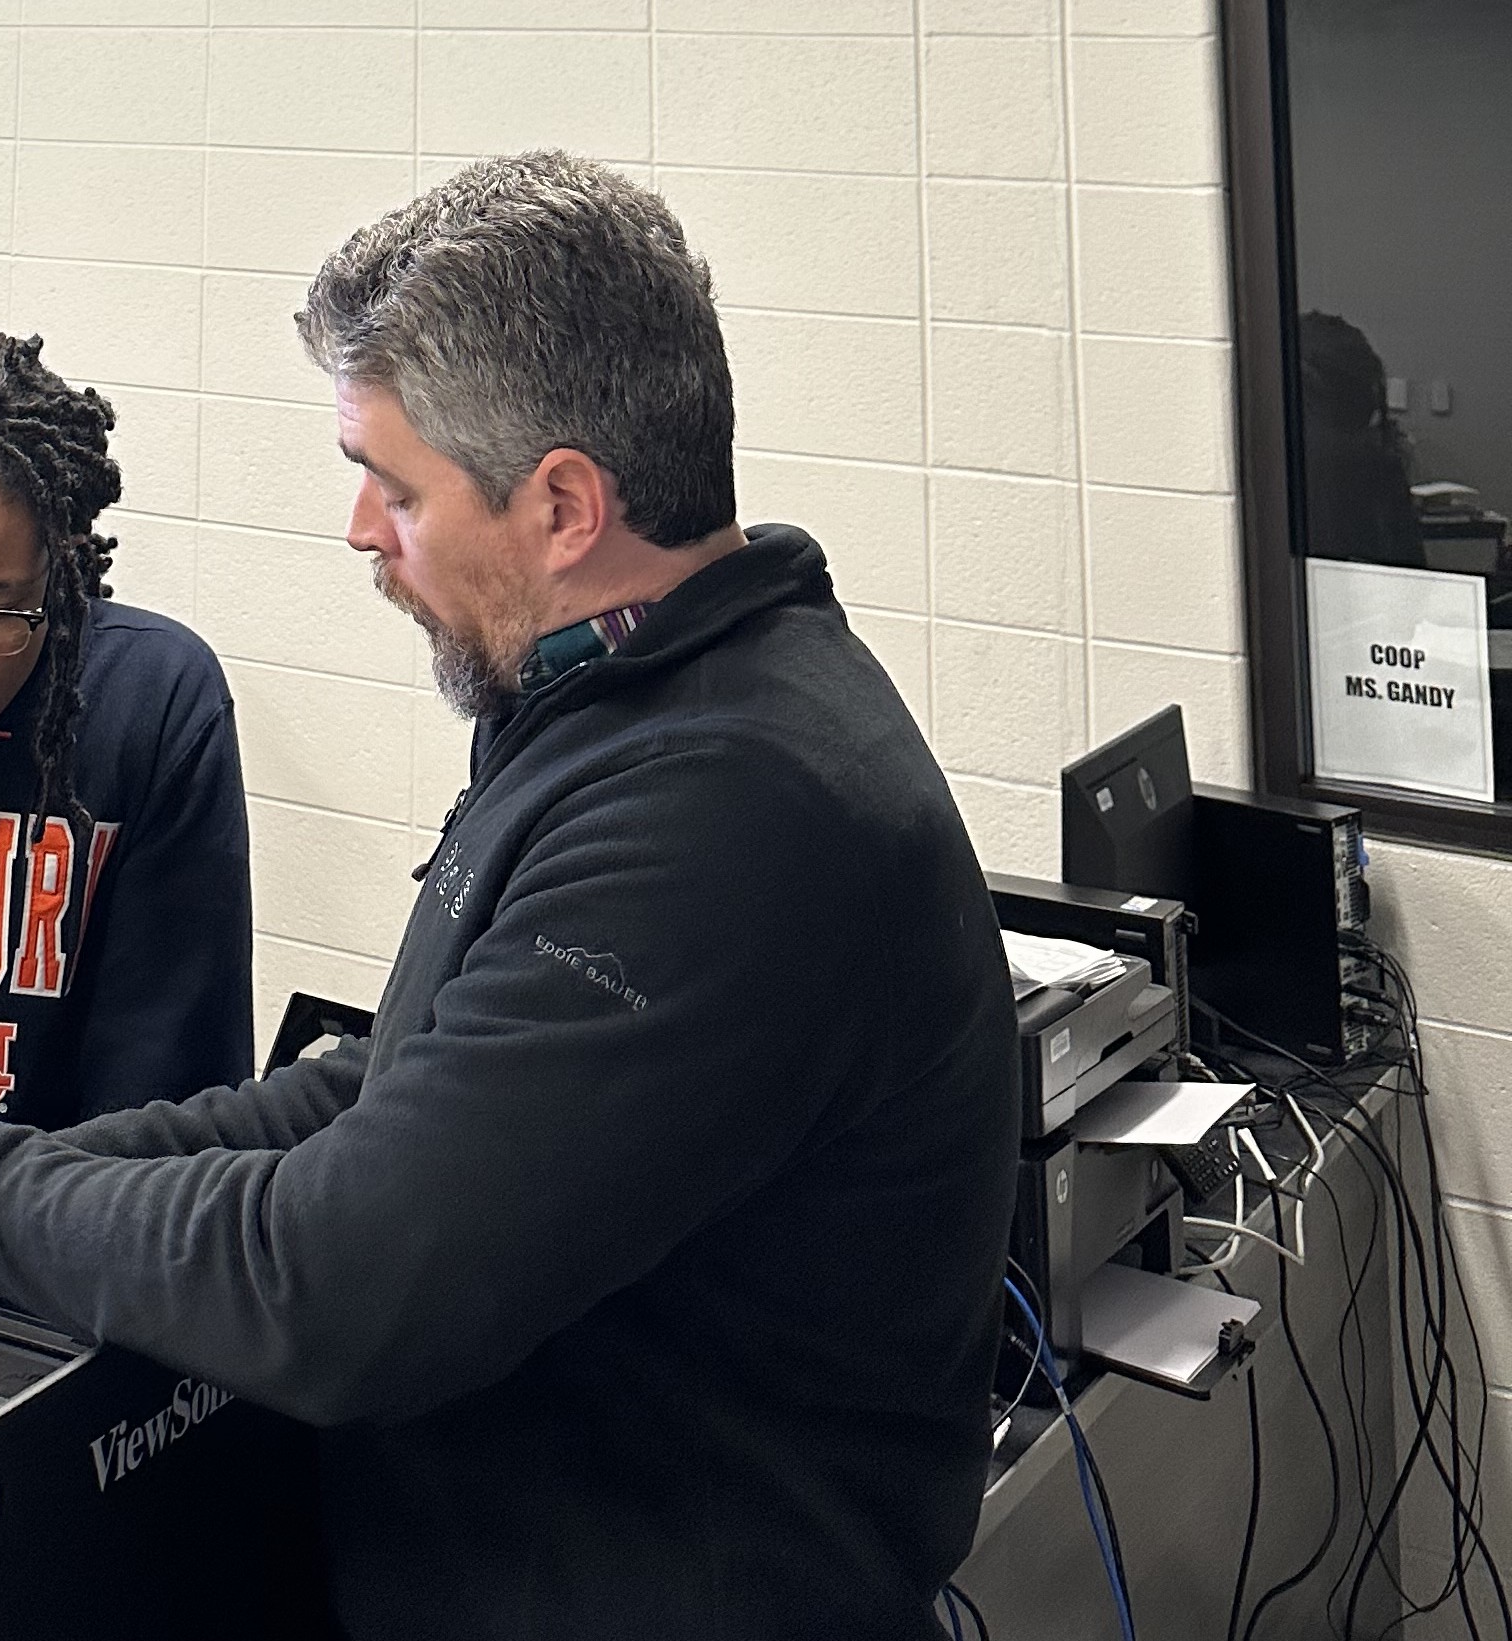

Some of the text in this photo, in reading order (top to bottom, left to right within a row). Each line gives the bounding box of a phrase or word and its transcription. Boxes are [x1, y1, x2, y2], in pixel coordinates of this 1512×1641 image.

[1370, 644, 1426, 669] COOP
[1345, 675, 1456, 709] MS. GANDY
[535, 934, 647, 1011] EDDIE BAUER
[89, 1377, 235, 1493] ViewSon
